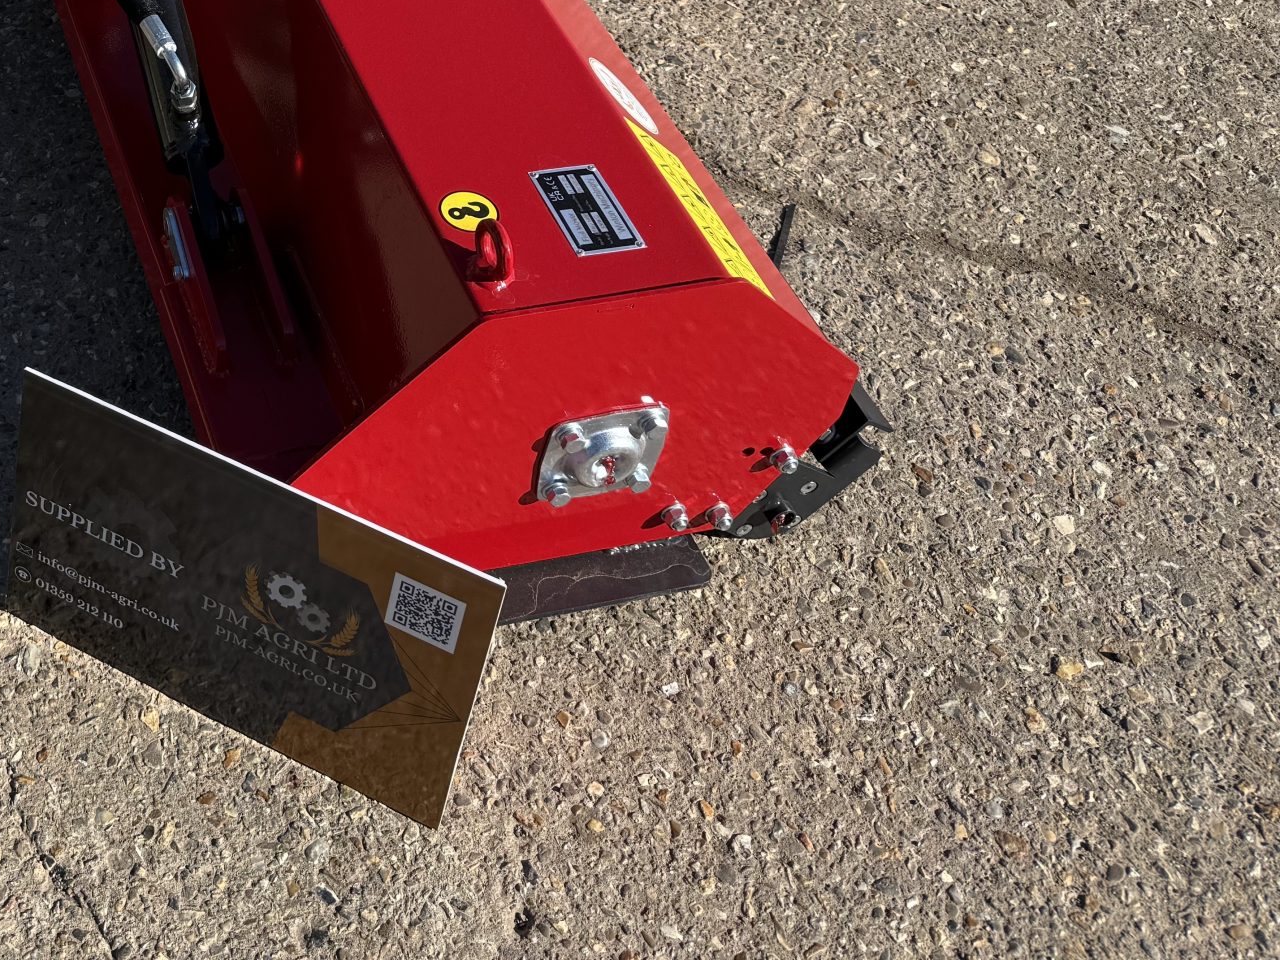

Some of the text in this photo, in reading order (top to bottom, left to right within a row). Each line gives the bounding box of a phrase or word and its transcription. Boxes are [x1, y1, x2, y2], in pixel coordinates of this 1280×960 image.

[25, 490, 185, 579] SUPPLIED BY
[35, 577, 124, 629] 01359 212 110
[38, 551, 180, 632] info@pjm-agri.co.uk
[201, 594, 378, 690] PJM AGRI LTD
[215, 625, 361, 704] PJM-AGRI.CO.UK
